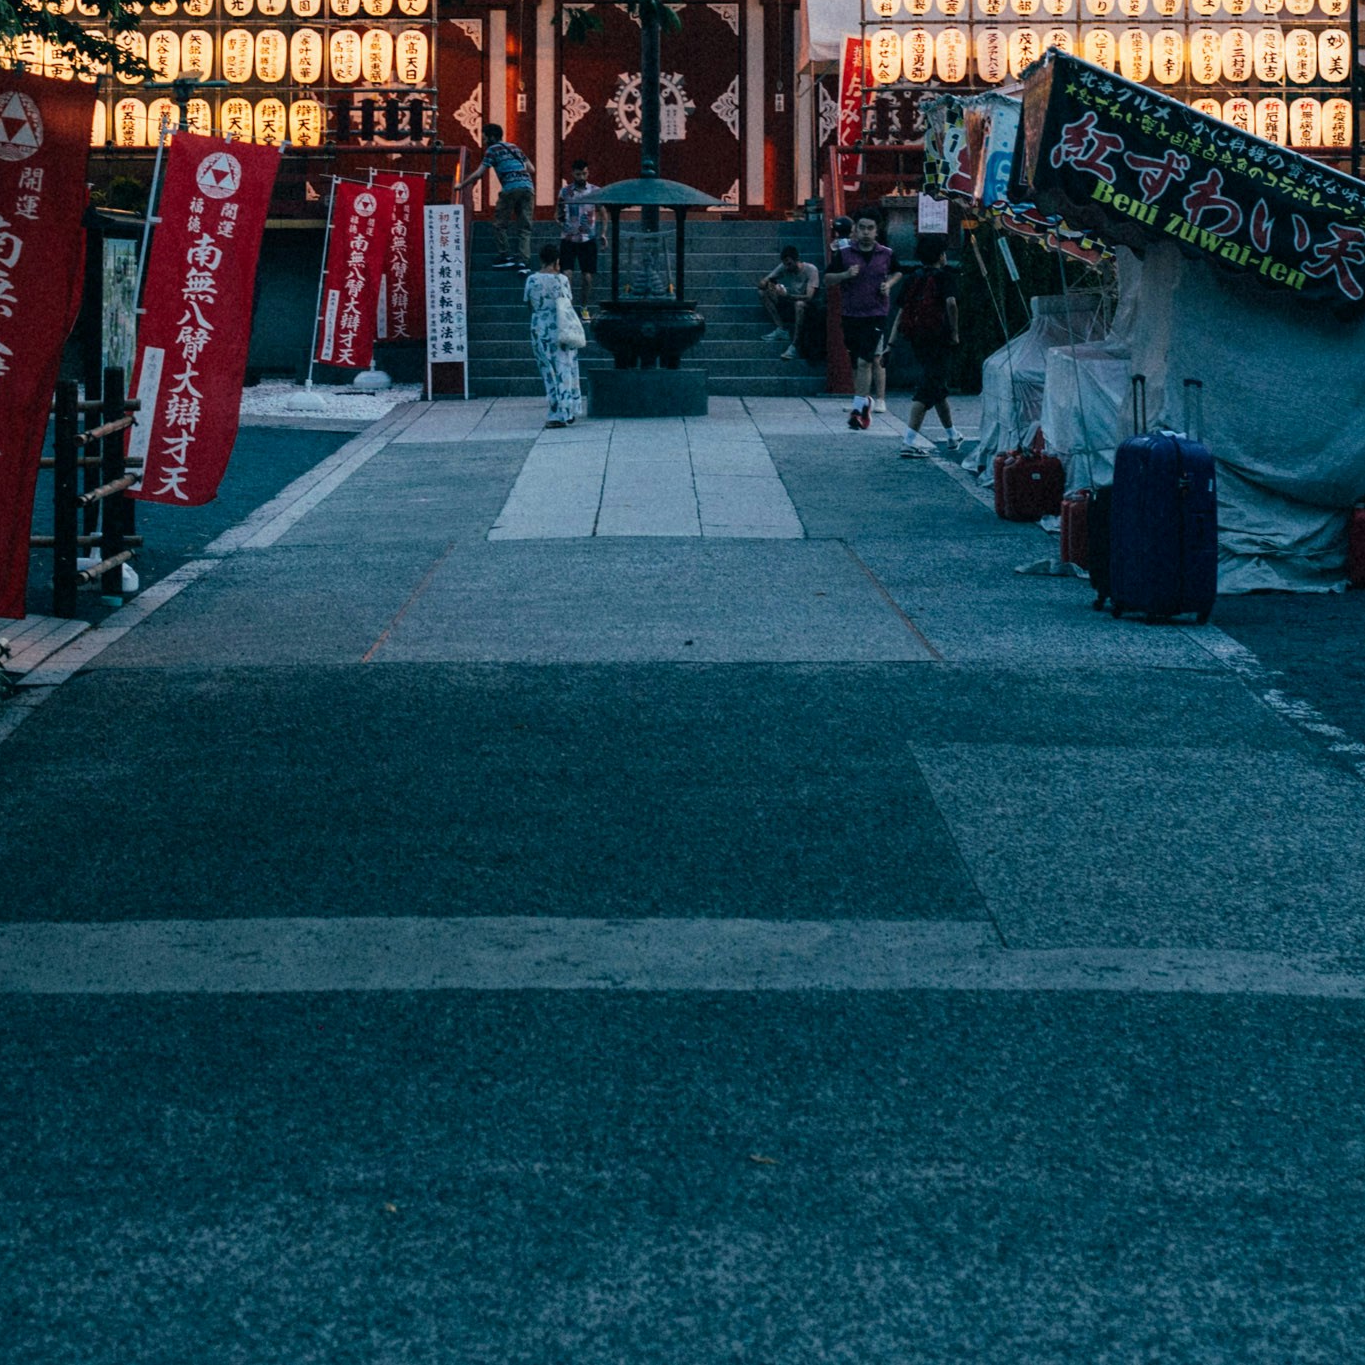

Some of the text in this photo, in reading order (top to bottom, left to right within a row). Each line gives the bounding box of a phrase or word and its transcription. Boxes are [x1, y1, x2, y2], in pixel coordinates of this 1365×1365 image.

[15, 166, 45, 221] 開運
[187, 196, 206, 234] 福徳
[216, 201, 239, 239] 開運
[1090, 179, 1308, 291] Beni Zuwai-ten
